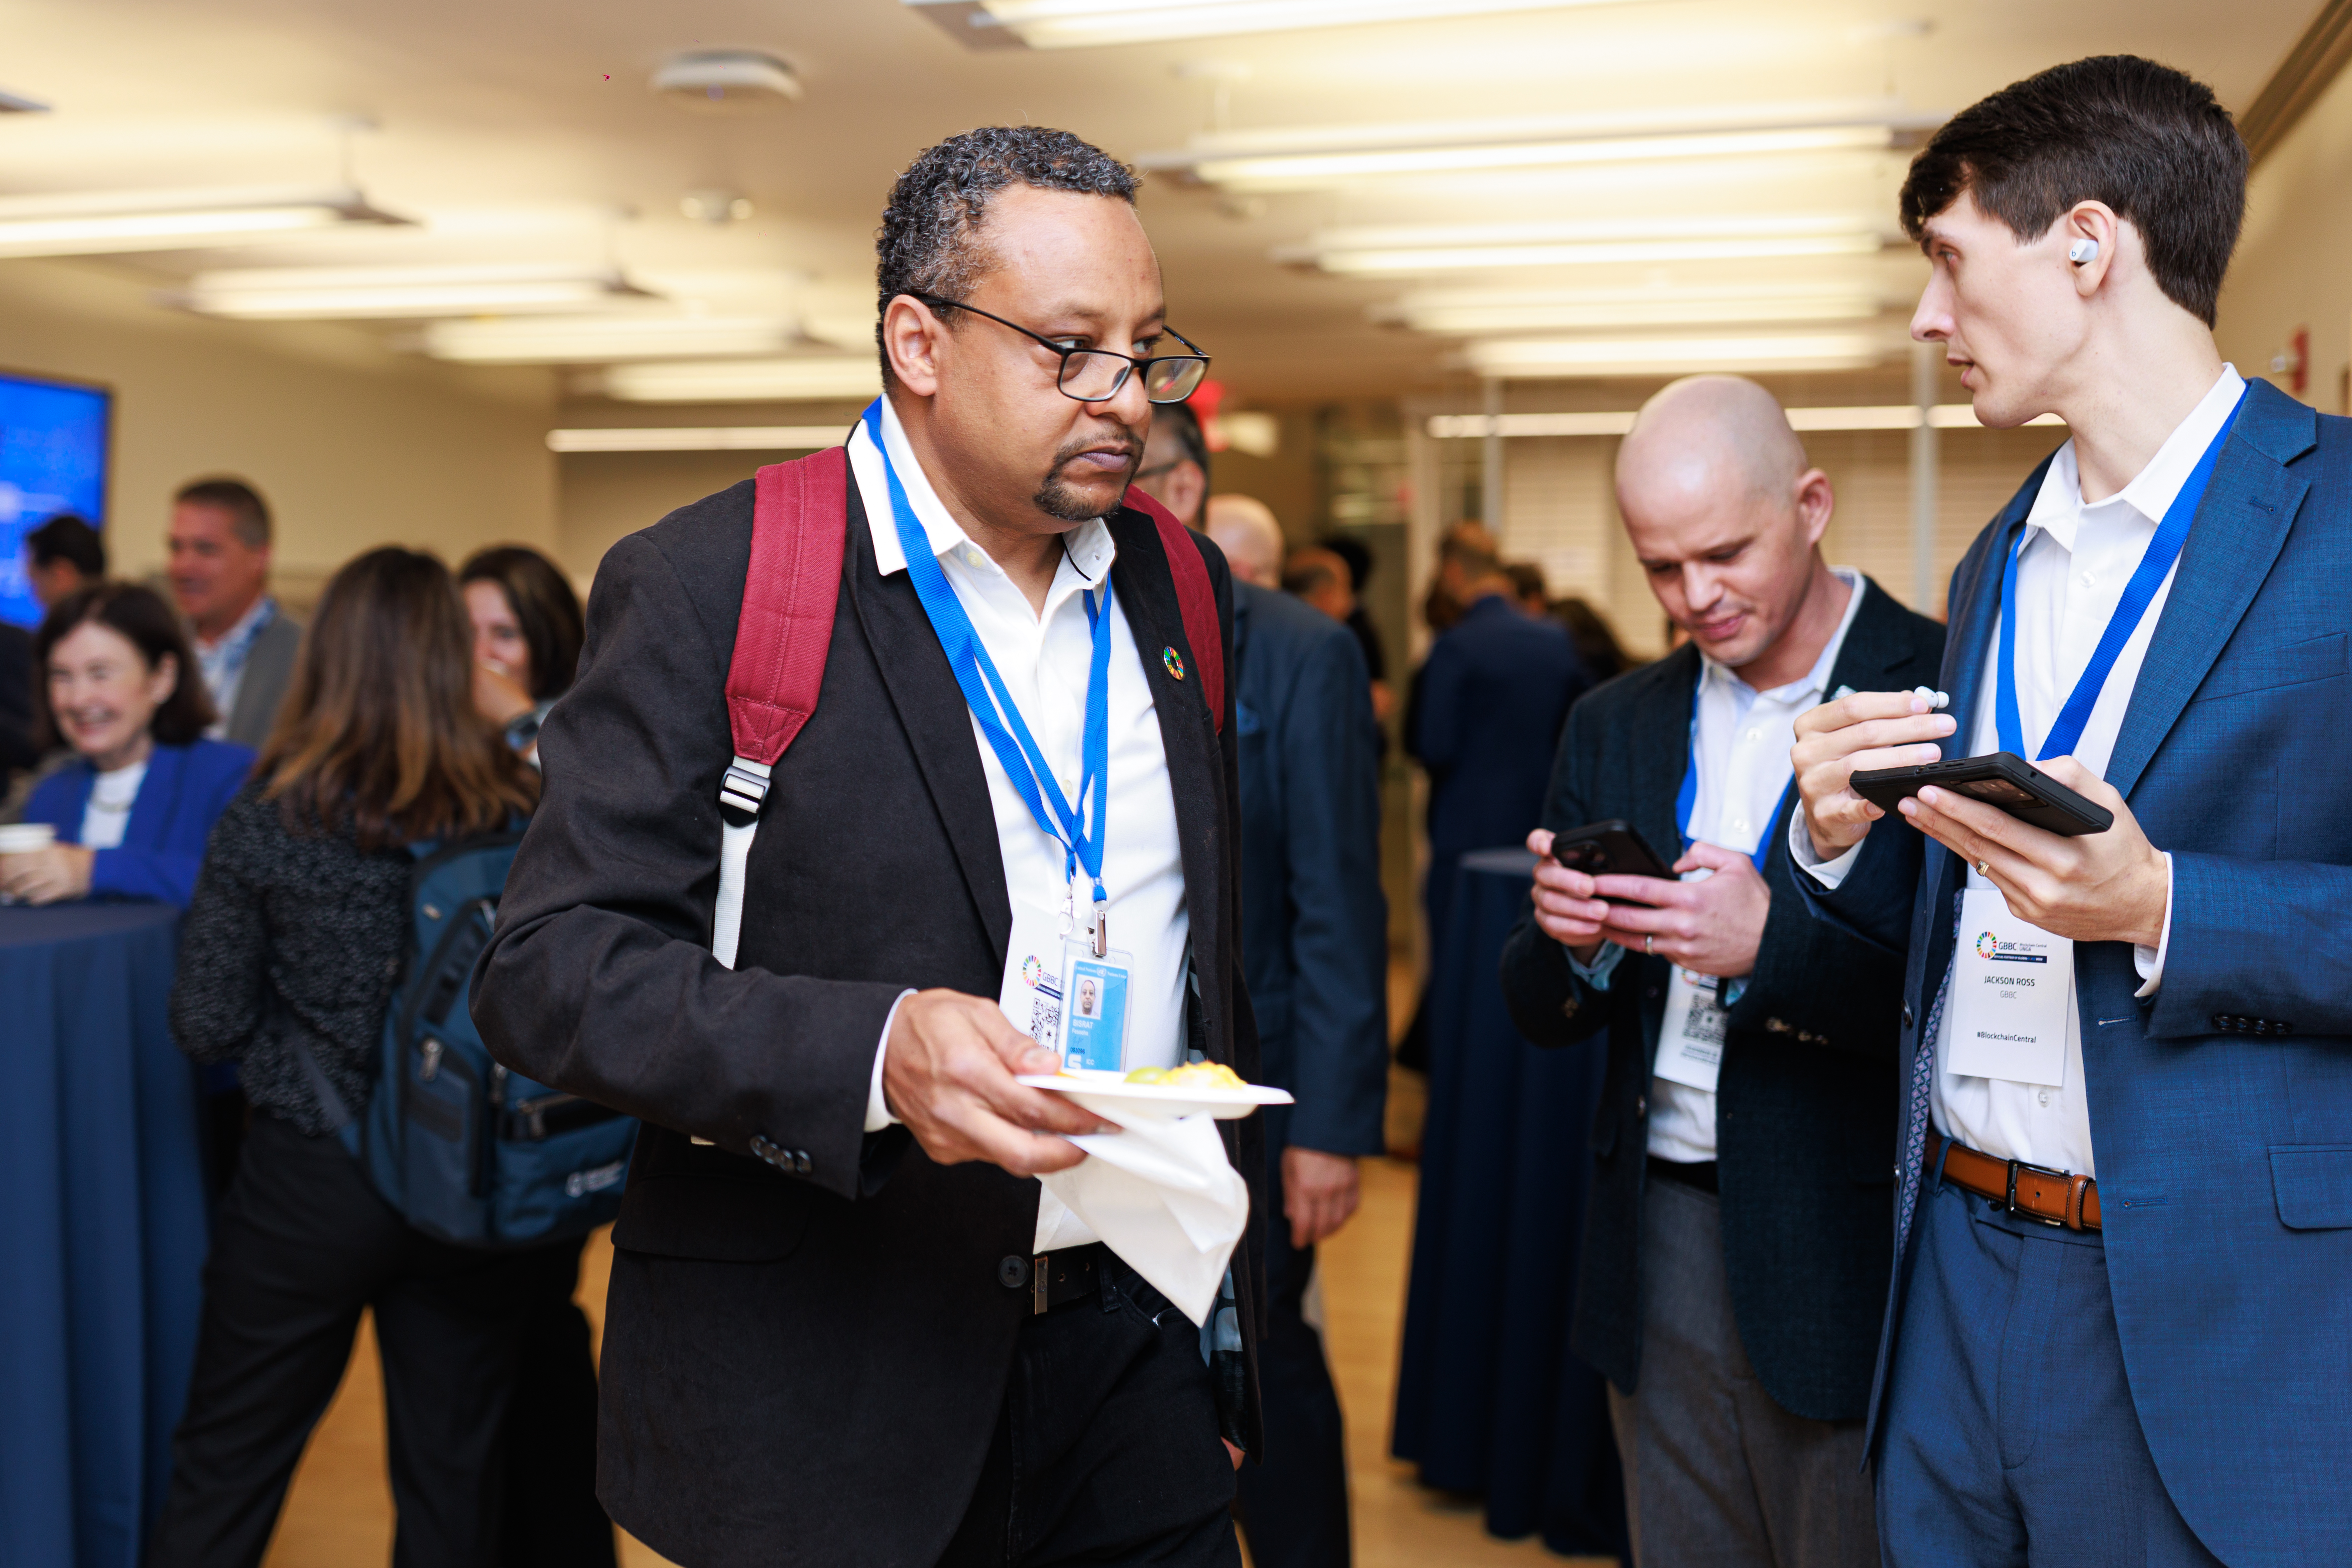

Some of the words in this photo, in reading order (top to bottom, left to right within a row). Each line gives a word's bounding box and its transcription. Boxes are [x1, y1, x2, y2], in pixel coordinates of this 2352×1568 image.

[1998, 942, 2017, 951] GBBC
[1042, 972, 1058, 986] GBBC
[1984, 975, 2014, 985] JACKSON
[2016, 978, 2035, 986] ROSS
[2000, 990, 2017, 999] GBBC
[1073, 1019, 1094, 1029] BISRAT
[1977, 1031, 2036, 1043] #BlockchainCentral
